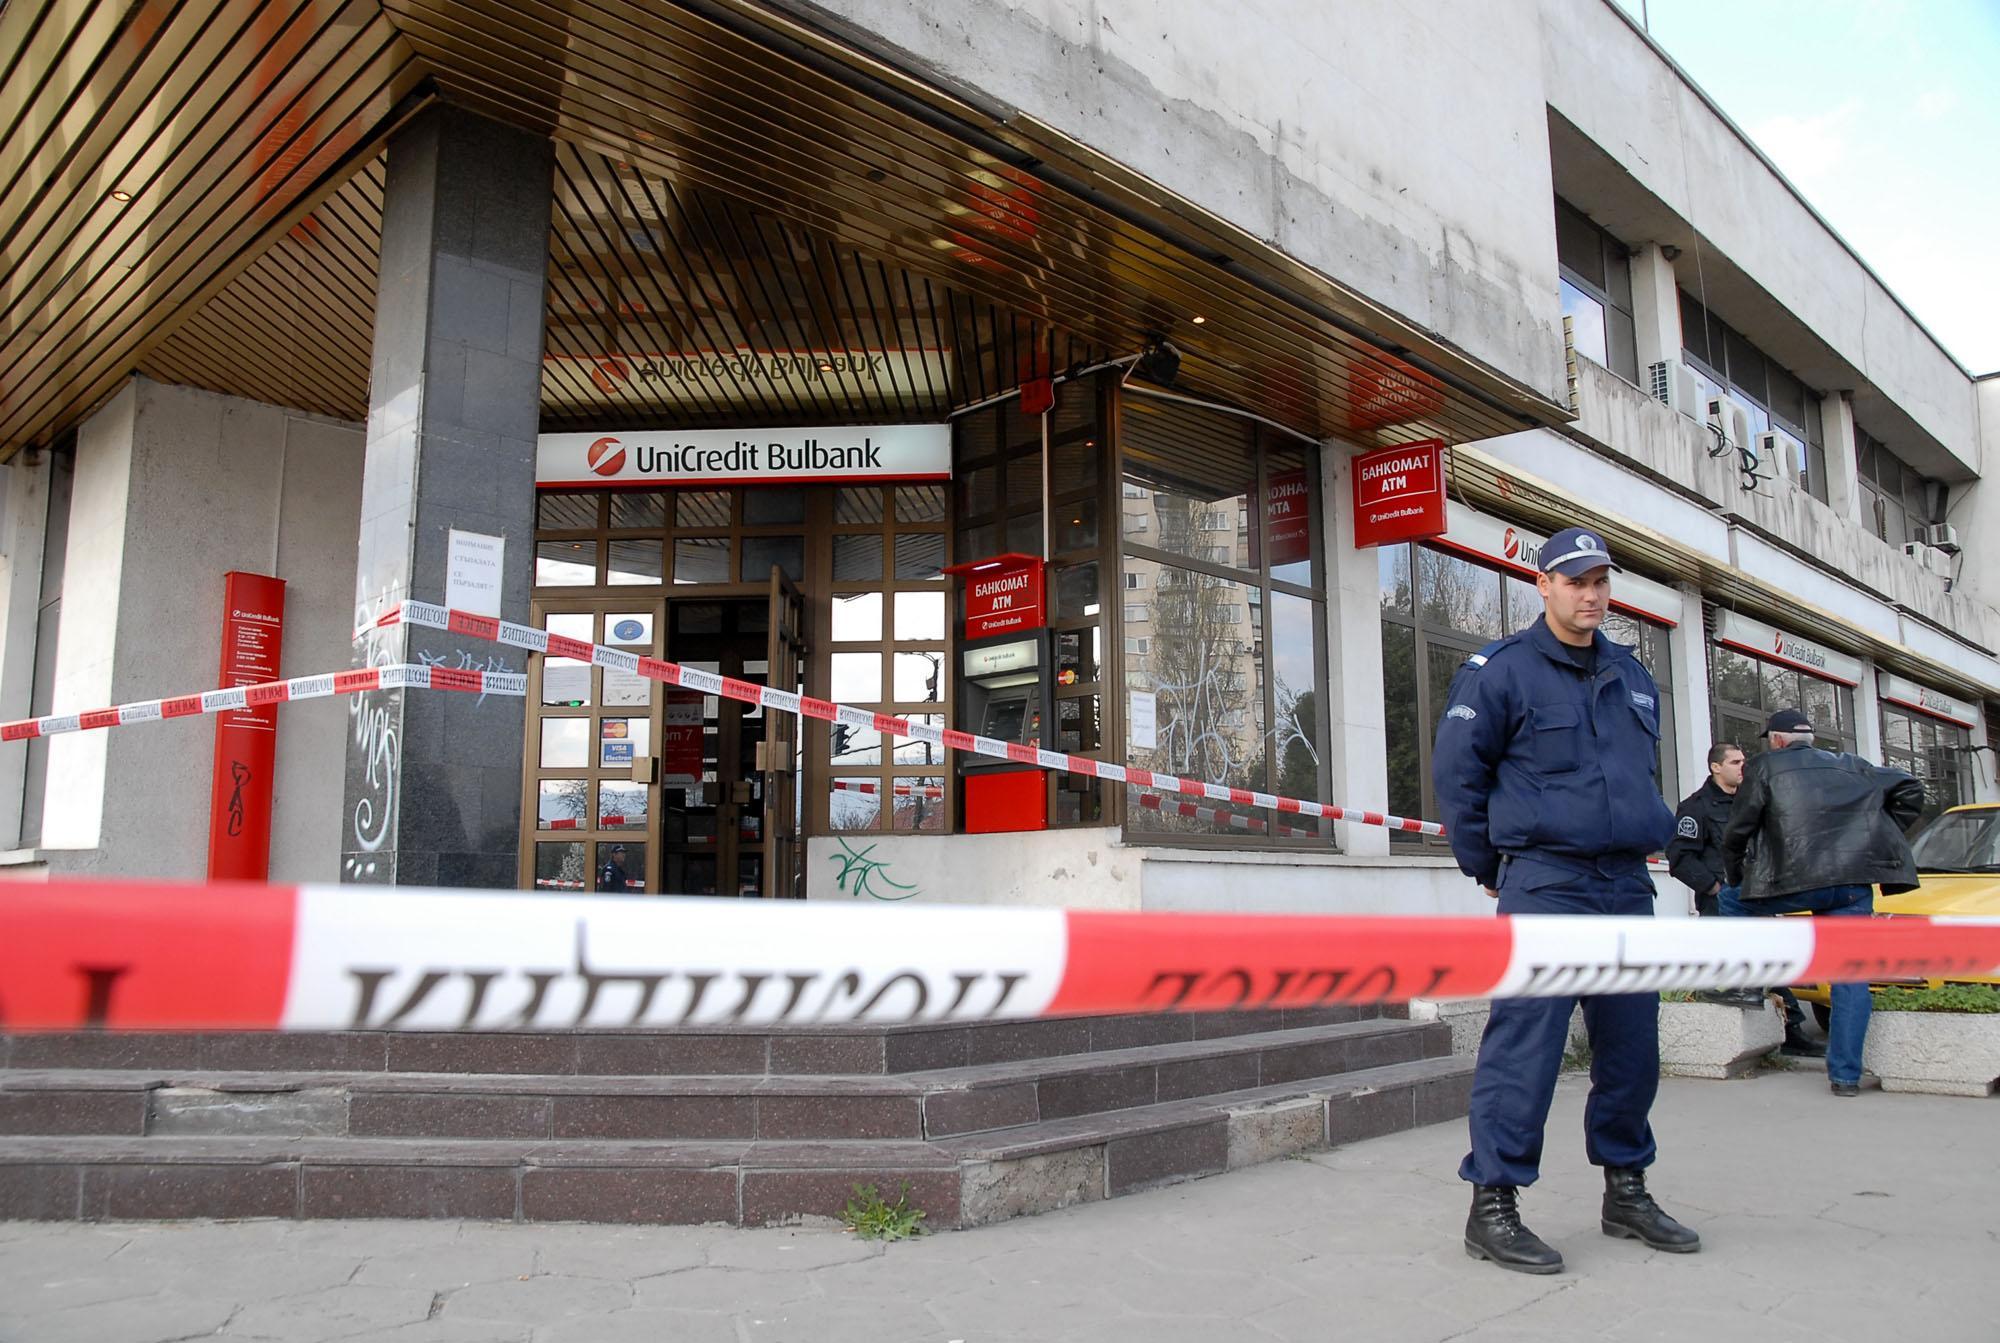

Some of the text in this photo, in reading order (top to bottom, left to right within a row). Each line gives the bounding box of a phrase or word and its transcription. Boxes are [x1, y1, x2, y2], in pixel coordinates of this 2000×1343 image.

[636, 437, 882, 473] UniCredit Bulbank
[1362, 455, 1430, 481] БАНКОМАТ
[1381, 475, 1407, 493] ATM
[975, 575, 1029, 598] БАНКОМАТ
[992, 595, 1012, 611] ATM
[501, 626, 547, 648] ПОЛИЦИЯ
[595, 648, 638, 671] ПОЛИЦИЯ
[382, 667, 429, 684] ПОЛИЦИЯ
[485, 675, 527, 692] ОЛИЦИЯ
[291, 677, 333, 696] ПОЛИЦИЯ
[204, 689, 245, 709] ПОЛИЦИЯ
